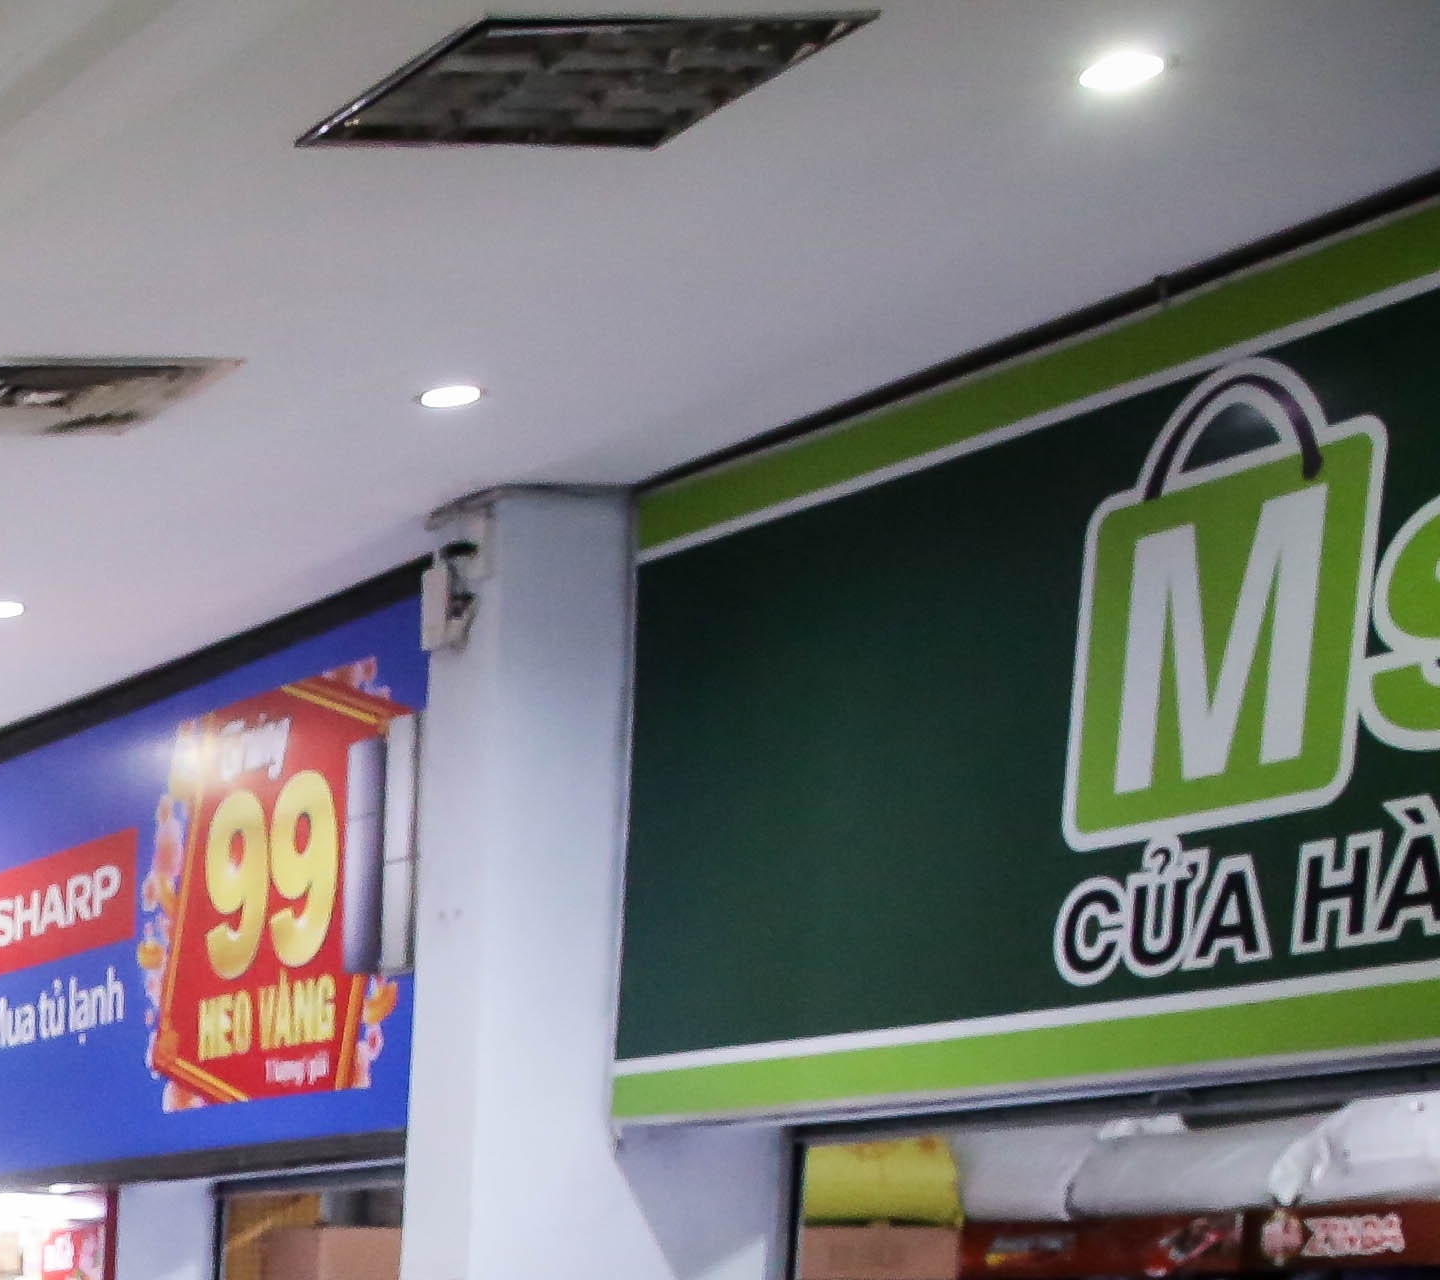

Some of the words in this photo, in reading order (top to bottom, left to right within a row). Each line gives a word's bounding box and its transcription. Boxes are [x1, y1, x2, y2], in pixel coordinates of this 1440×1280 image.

[205, 769, 339, 981] 99
[1054, 834, 1272, 986] CỬA
[39, 977, 66, 1039] tủ
[68, 966, 125, 1046] lạnh
[198, 990, 252, 1061] HEO
[258, 970, 336, 1050] VÀNG
